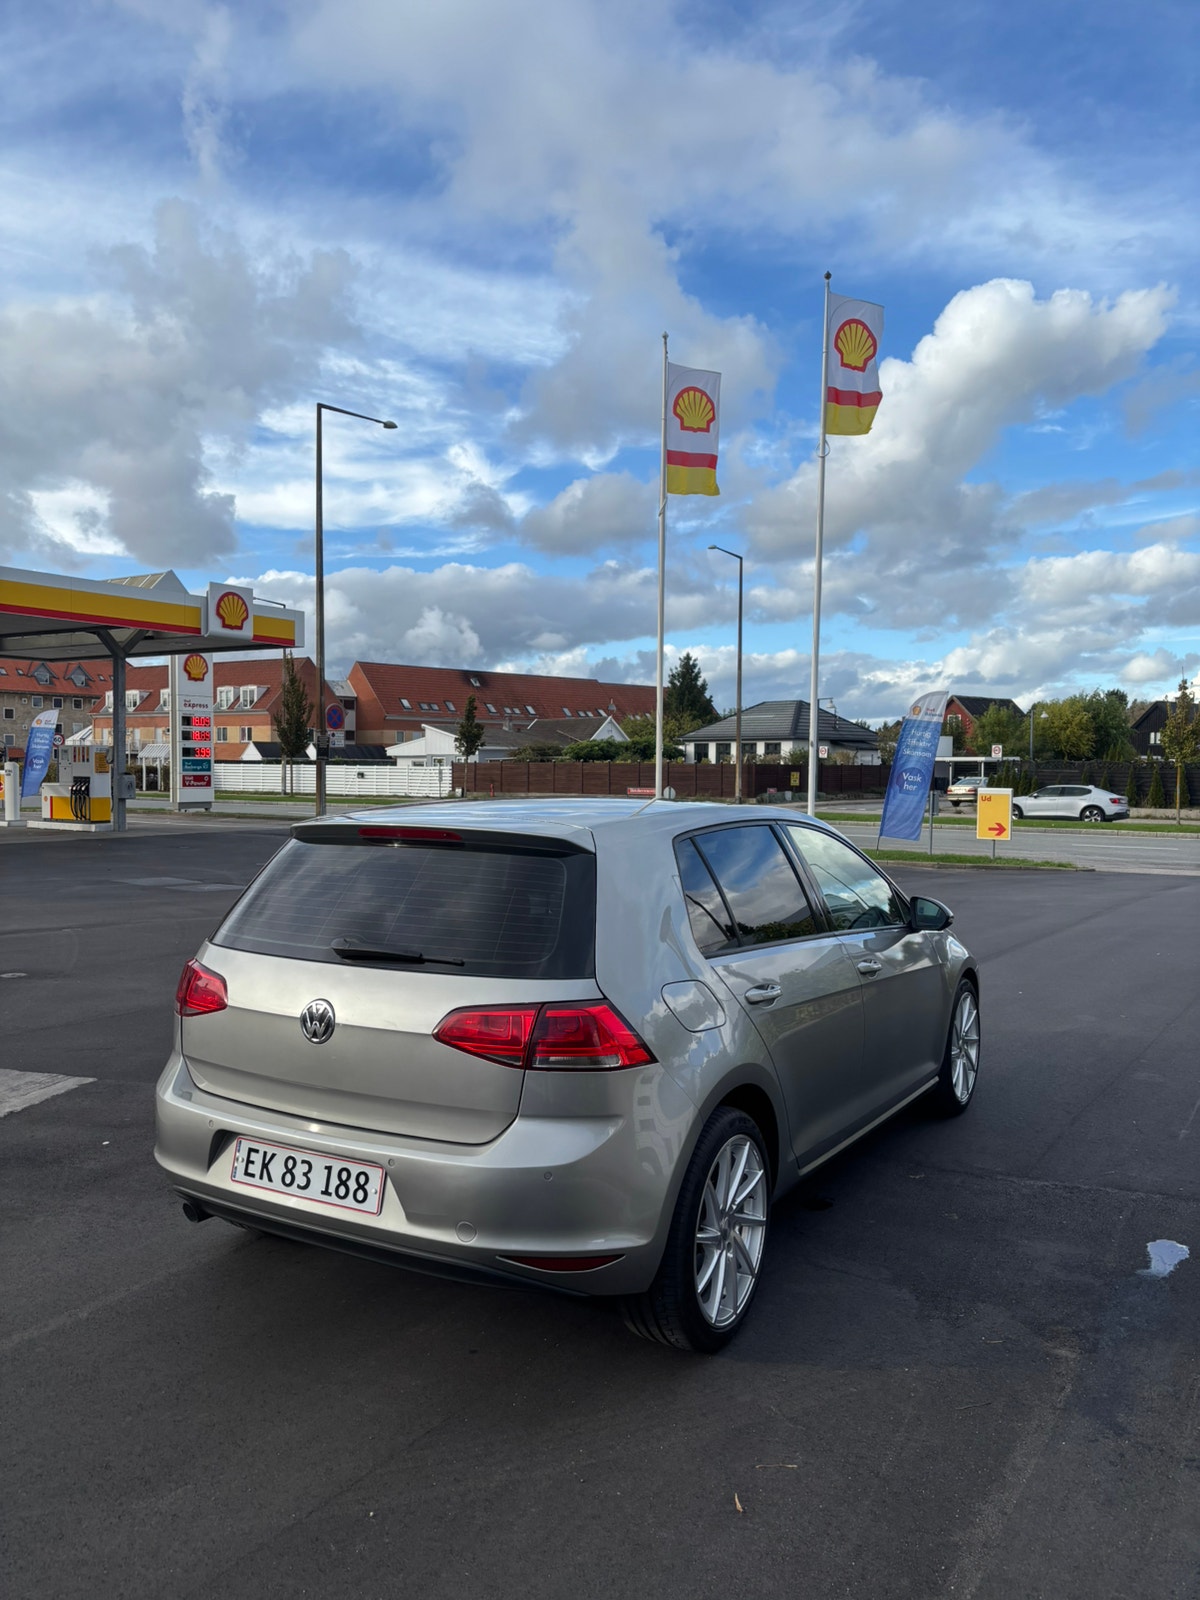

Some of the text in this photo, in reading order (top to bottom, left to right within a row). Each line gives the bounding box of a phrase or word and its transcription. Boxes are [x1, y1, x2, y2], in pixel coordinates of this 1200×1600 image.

[183, 702, 209, 710] express
[902, 772, 922, 783] Vask
[903, 781, 918, 791] her
[243, 1147, 370, 1204] EK 83 188
